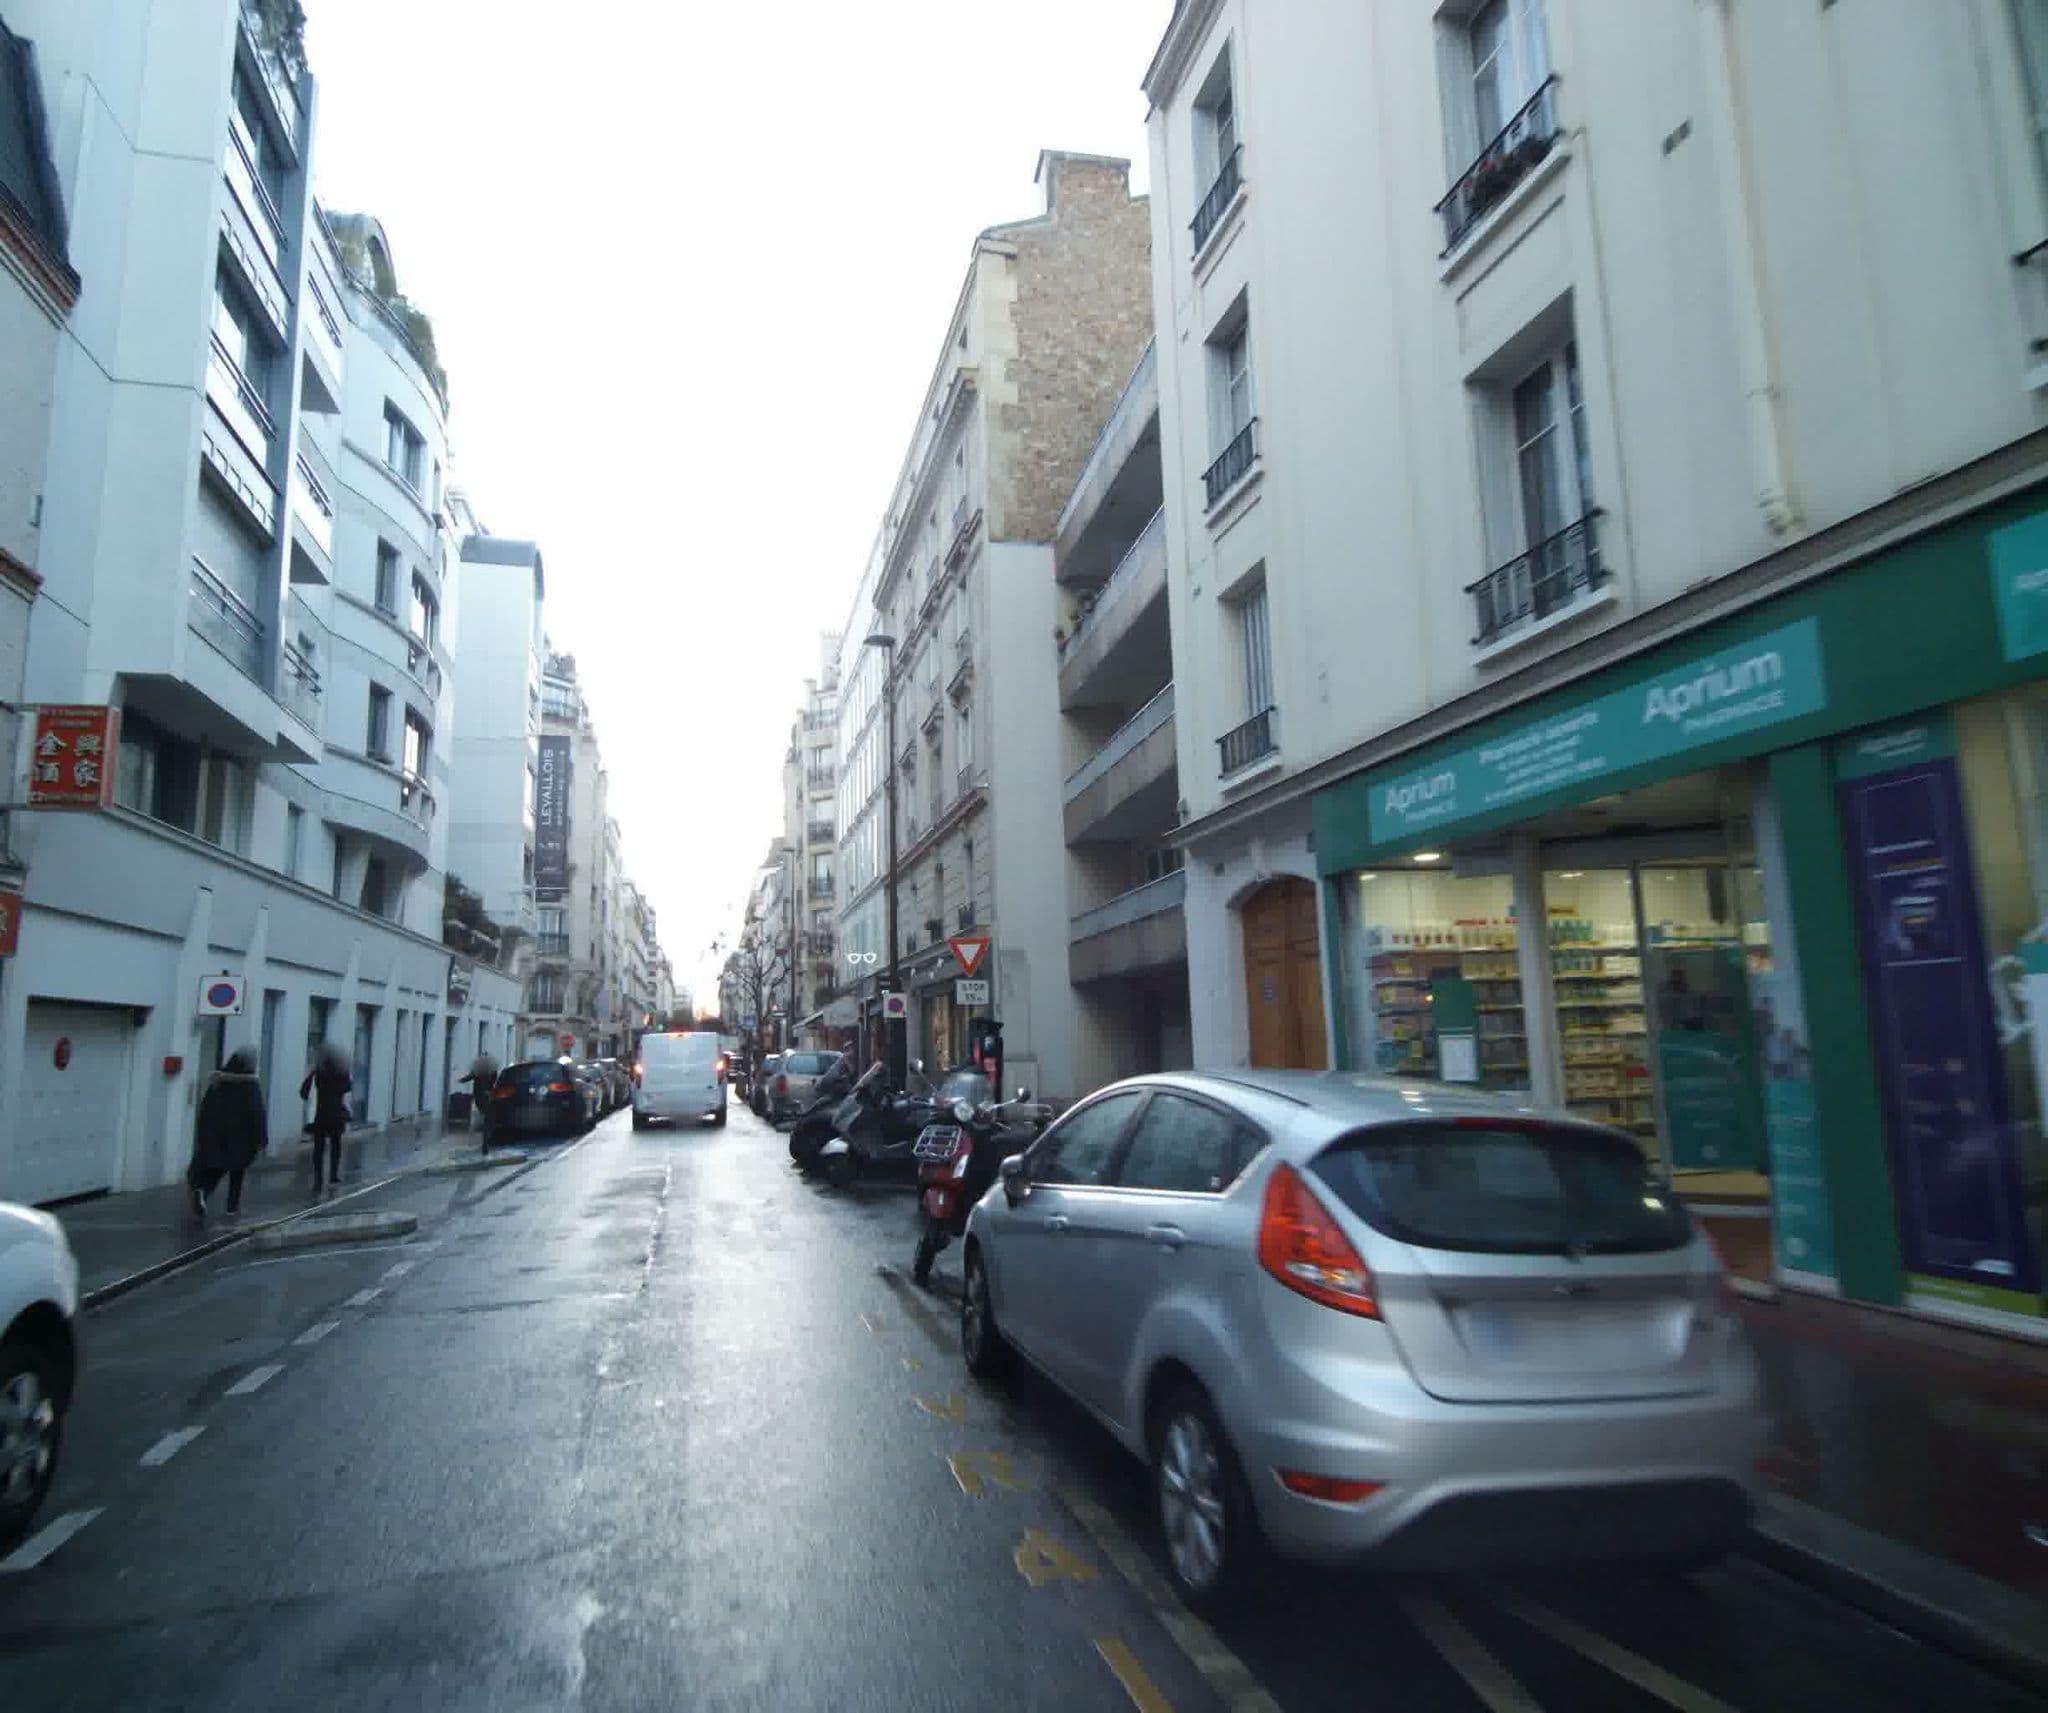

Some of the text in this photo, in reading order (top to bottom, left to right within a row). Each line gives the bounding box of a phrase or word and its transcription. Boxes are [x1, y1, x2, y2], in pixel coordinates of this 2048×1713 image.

[1642, 650, 1781, 724] Aprium
[541, 748, 554, 826] LEVALLOIS
[1385, 770, 1457, 816] Aprium
